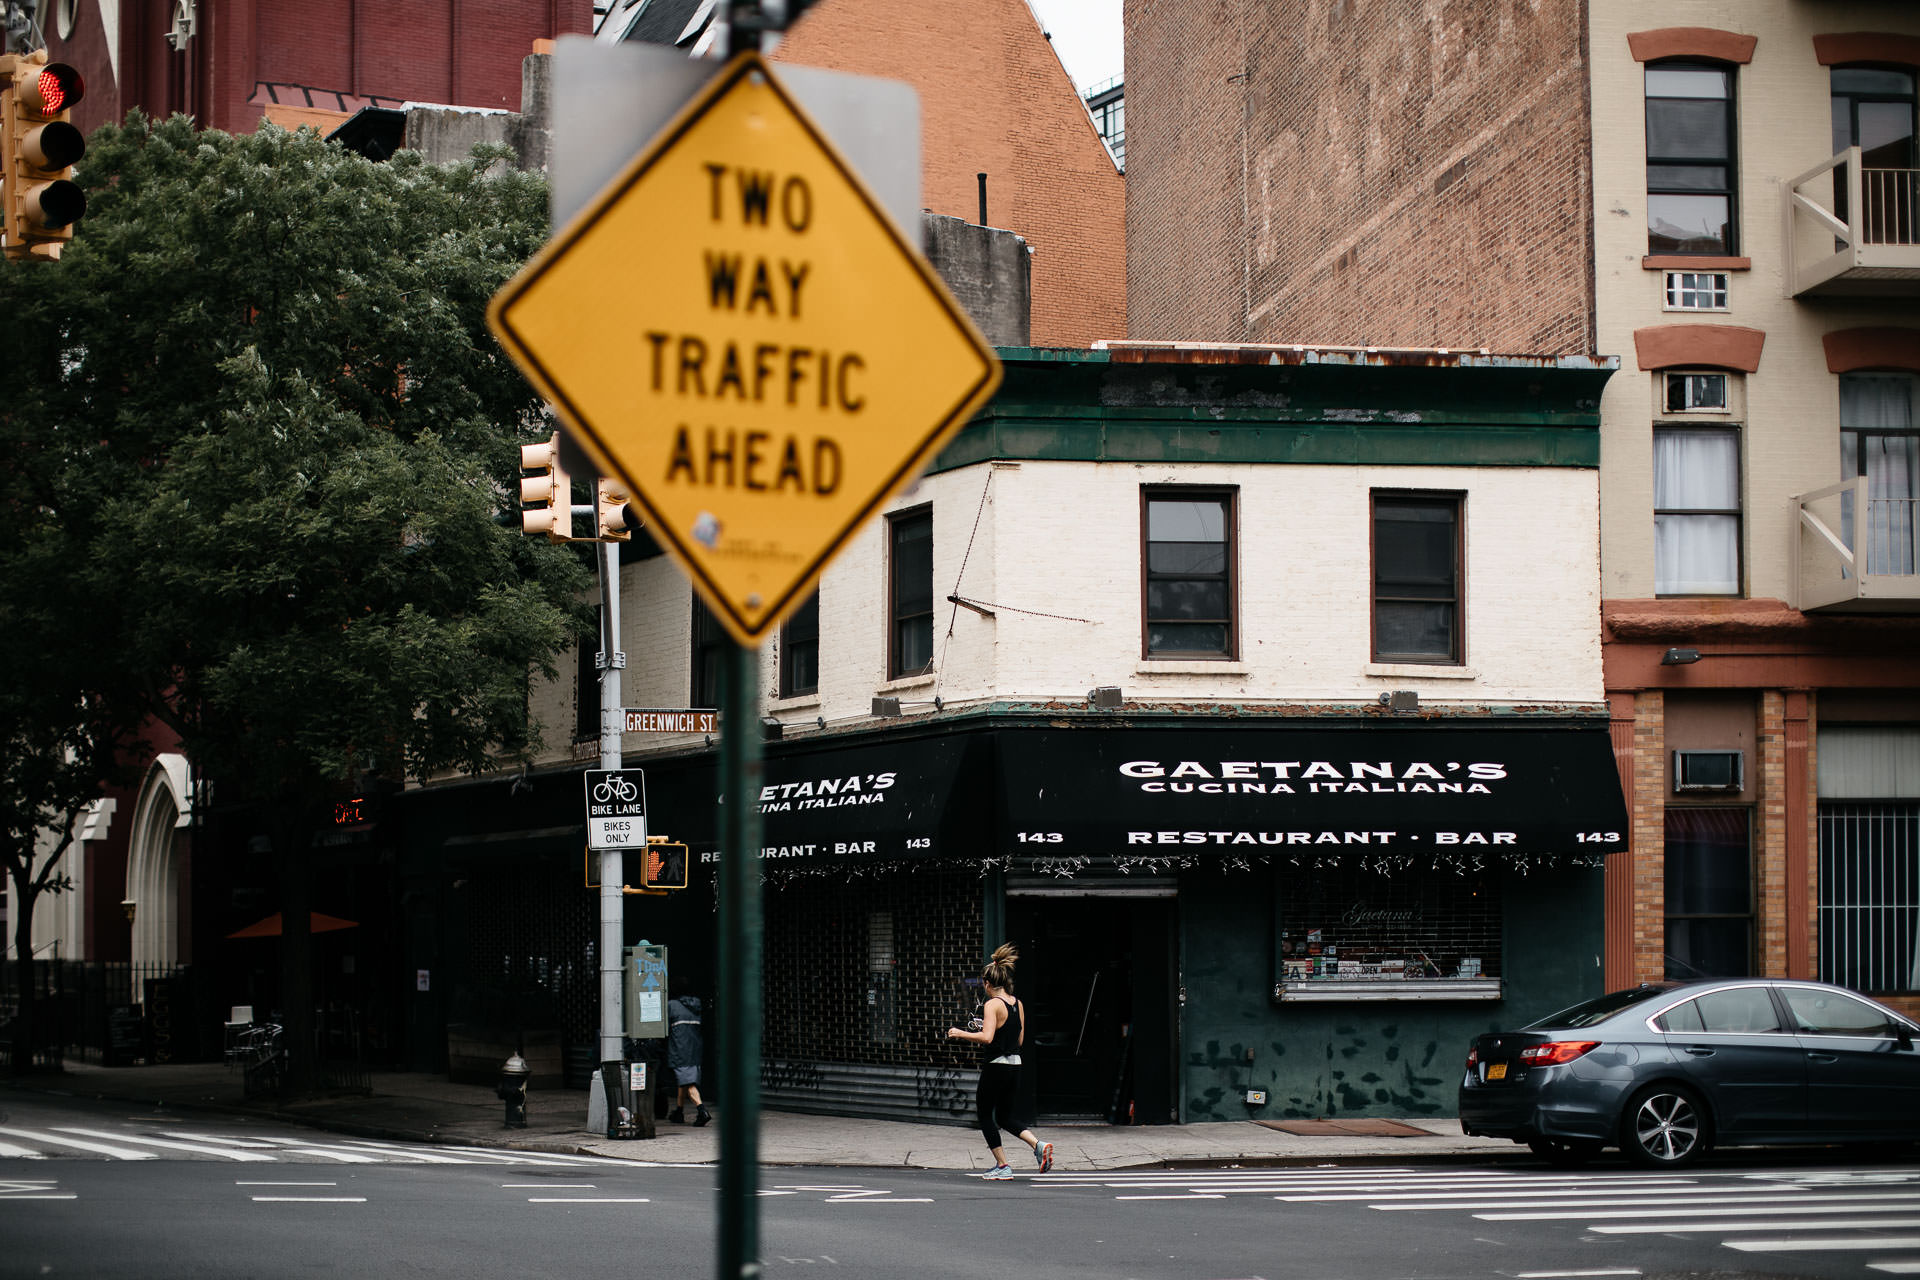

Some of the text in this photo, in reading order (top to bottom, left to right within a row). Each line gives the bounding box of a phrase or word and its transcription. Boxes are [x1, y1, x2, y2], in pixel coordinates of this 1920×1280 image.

[703, 162, 814, 235] TWO
[702, 249, 811, 320] WAY
[643, 329, 868, 415] TRAFFIC
[665, 422, 843, 497] AHEAD
[626, 713, 713, 732] GREENWICH ST
[1119, 761, 1507, 780] GAETANA'S
[718, 772, 897, 804] ETANA'S
[1141, 782, 1492, 794] CUCINA ITALIANA
[591, 804, 642, 815] BIKE LANE
[797, 792, 884, 811] ITALIANA
[604, 821, 631, 832] BIKES
[605, 833, 630, 843] ONLY
[906, 838, 931, 849] 143
[1017, 832, 1064, 843] 143
[1127, 831, 1518, 844] RESTAURANT BAR
[1576, 832, 1621, 843] 143
[700, 841, 876, 863] REURANT BAR
